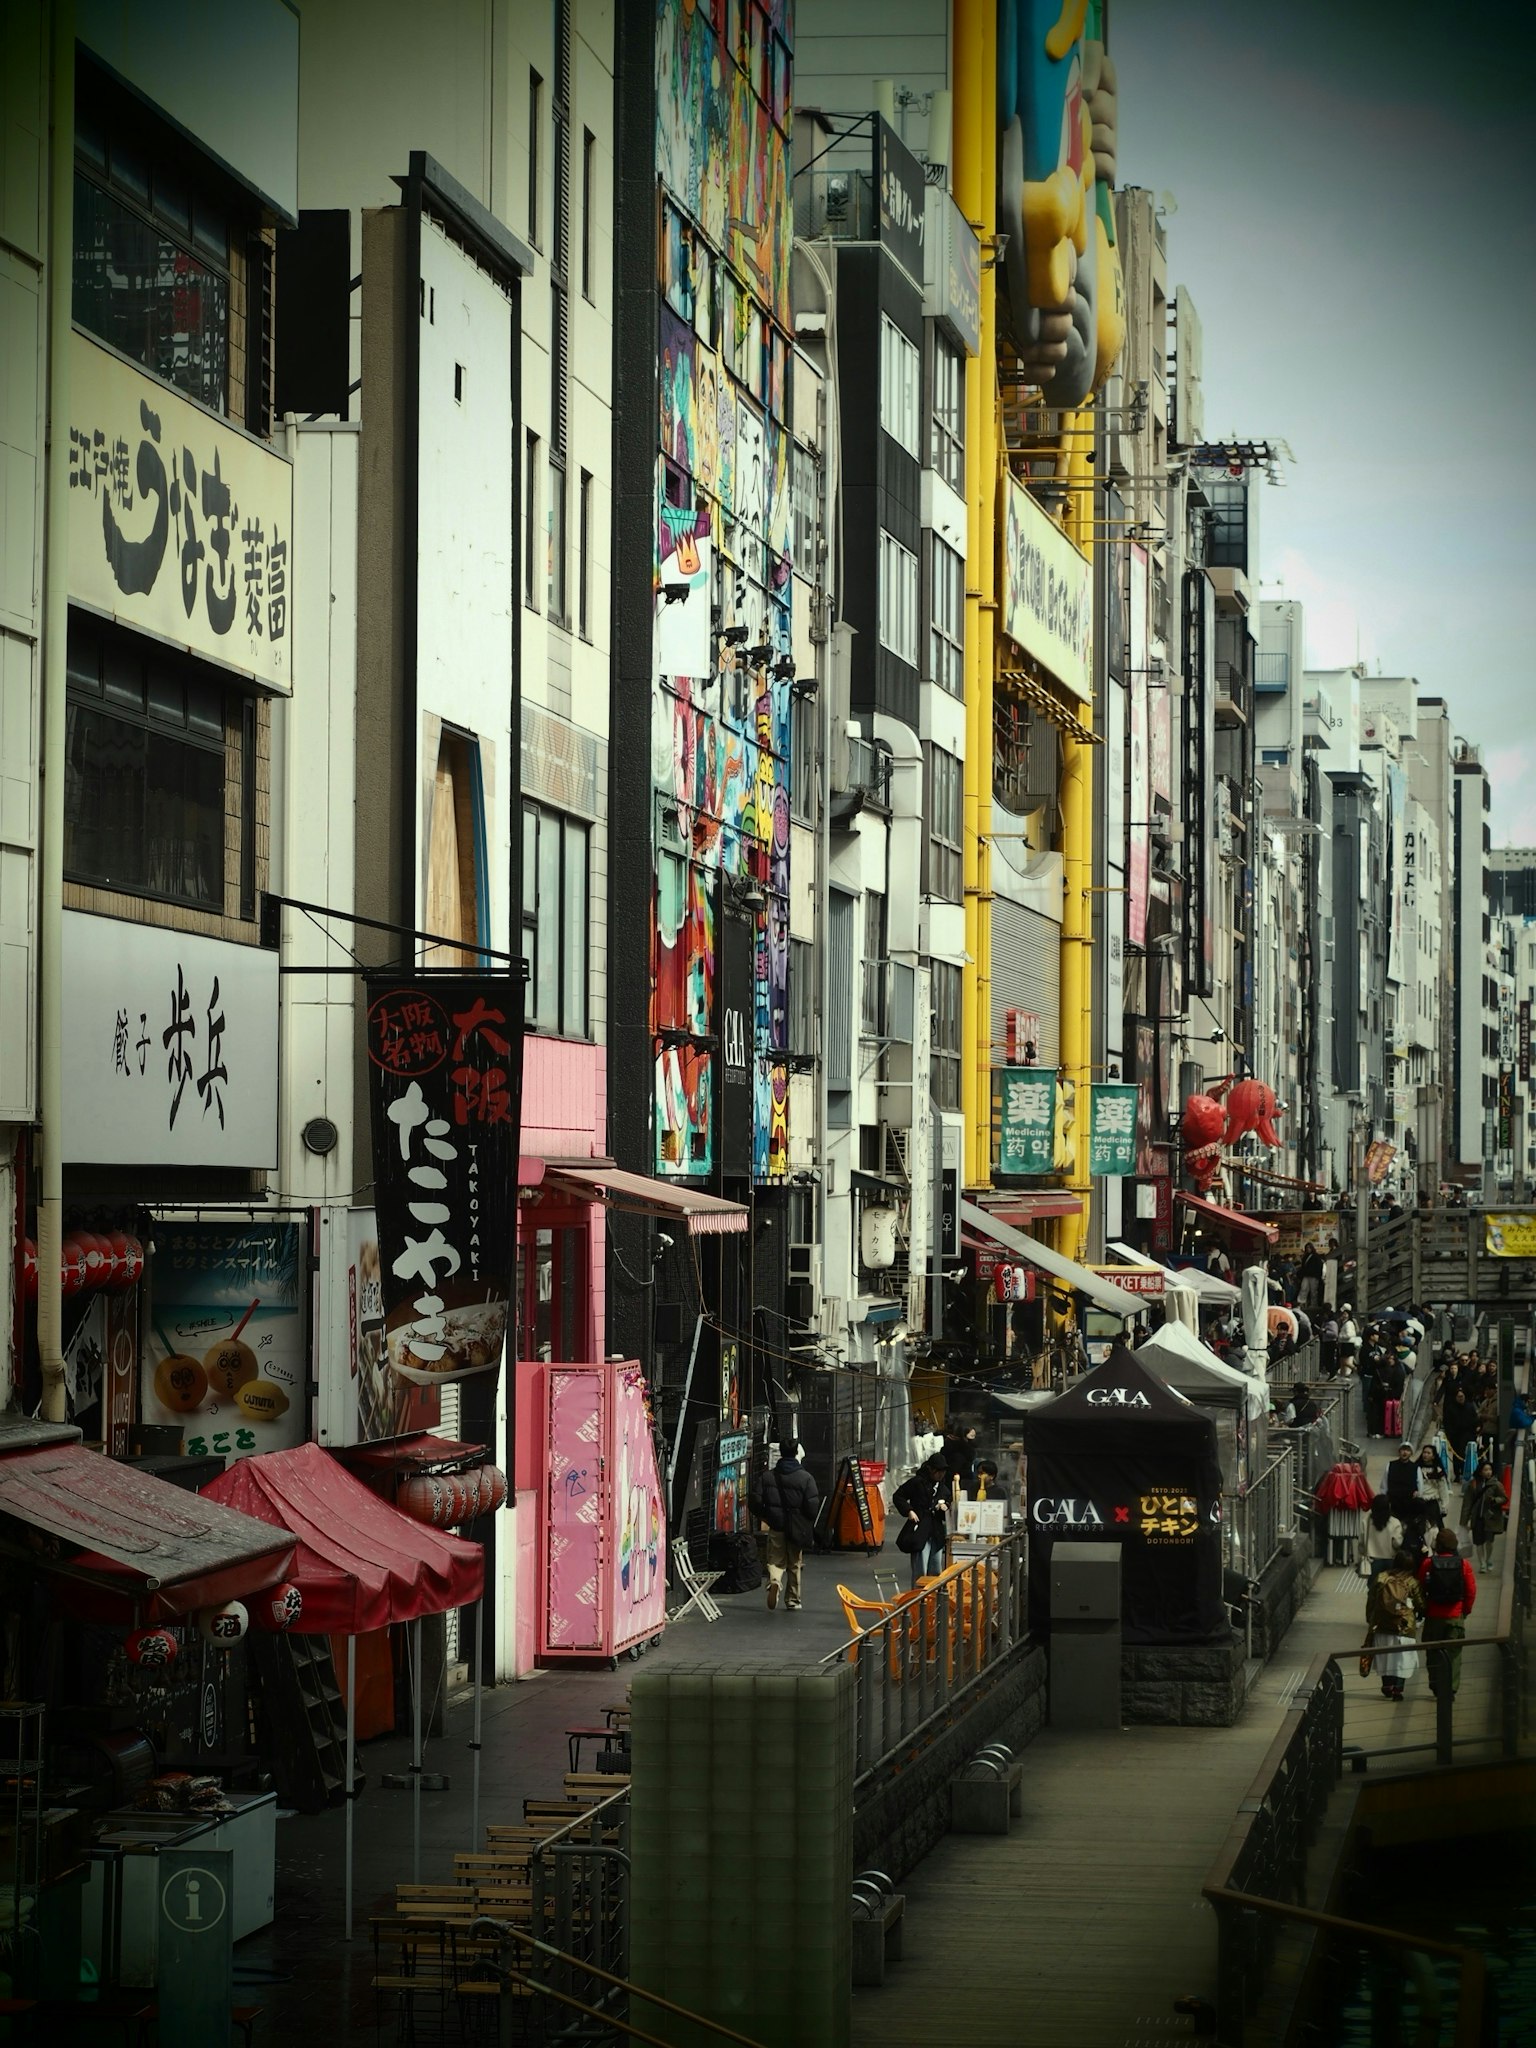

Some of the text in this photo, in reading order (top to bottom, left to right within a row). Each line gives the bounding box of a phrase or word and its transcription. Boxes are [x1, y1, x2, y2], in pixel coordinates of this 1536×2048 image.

[70, 398, 287, 642] 江戸焼 うなぎ 菱富
[372, 999, 436, 1039] 大阪
[724, 1007, 747, 1068] GALA
[111, 962, 229, 1132] 餃子 歩兵
[381, 1030, 445, 1068] 名物
[450, 996, 513, 1126] 大阪
[1007, 1082, 1050, 1125] 薬
[1095, 1096, 1133, 1134] 薬
[1006, 1128, 1050, 1137] Medicine
[1007, 1138, 1026, 1158] 药
[1094, 1135, 1133, 1144] Medicine
[1095, 1145, 1112, 1162] 药
[386, 1079, 461, 1362] たこやき
[467, 1144, 481, 1282] TAKOYAKI
[1086, 1388, 1152, 1406] GALA
[1033, 1498, 1105, 1525] GALA
[1140, 1517, 1200, 1537] チキン
[1146, 1537, 1194, 1545] DOTONBORI
[211, 1613, 242, 1638] 酒
